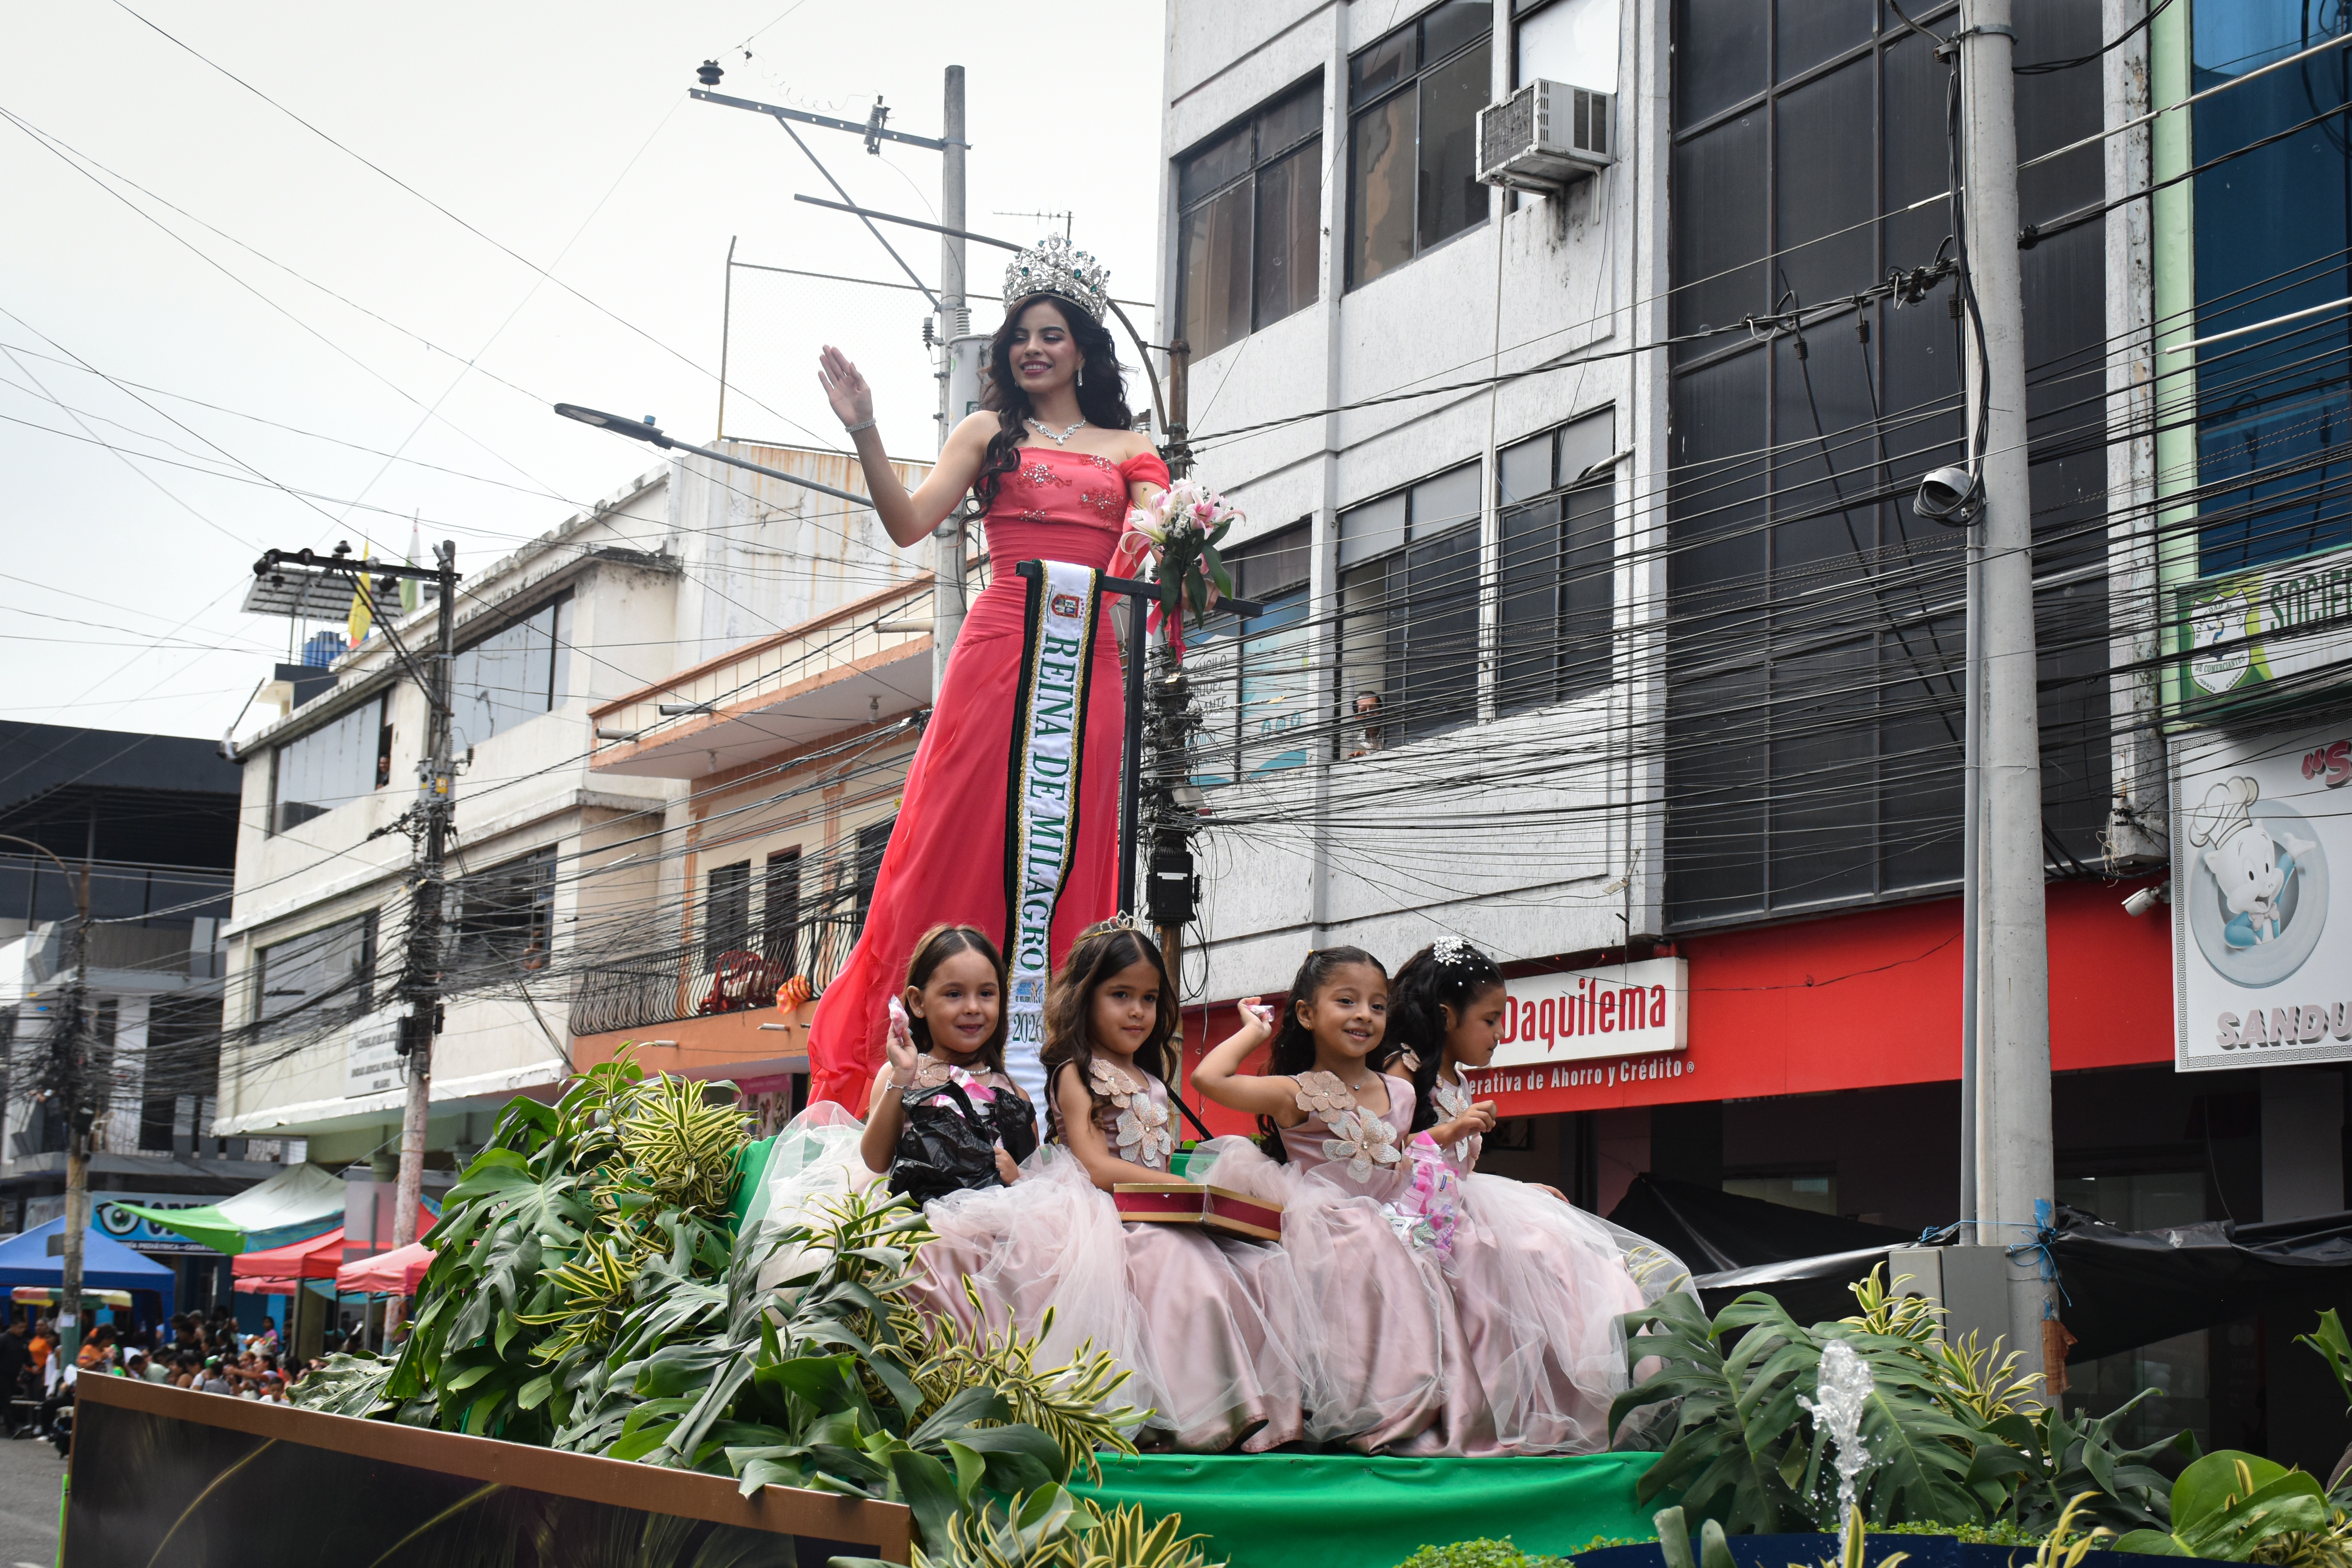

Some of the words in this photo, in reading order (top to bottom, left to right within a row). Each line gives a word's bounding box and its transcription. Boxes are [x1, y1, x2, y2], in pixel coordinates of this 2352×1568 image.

[1035, 632, 1080, 738] REINA
[2204, 654, 2245, 673] COMERCIANTES
[1030, 751, 1069, 801] DE
[1020, 810, 1065, 970] MILAGRO
[1013, 1013, 1044, 1044] 2026
[1499, 976, 1666, 1053] Daquilema
[2216, 1001, 2352, 1051] SANDU
[1469, 1072, 1521, 1095] erativa
[1527, 1070, 1544, 1090] de
[1551, 1066, 1602, 1088] Ahorro
[1608, 1066, 1616, 1087] y
[1621, 1057, 1682, 1082] Crédito
